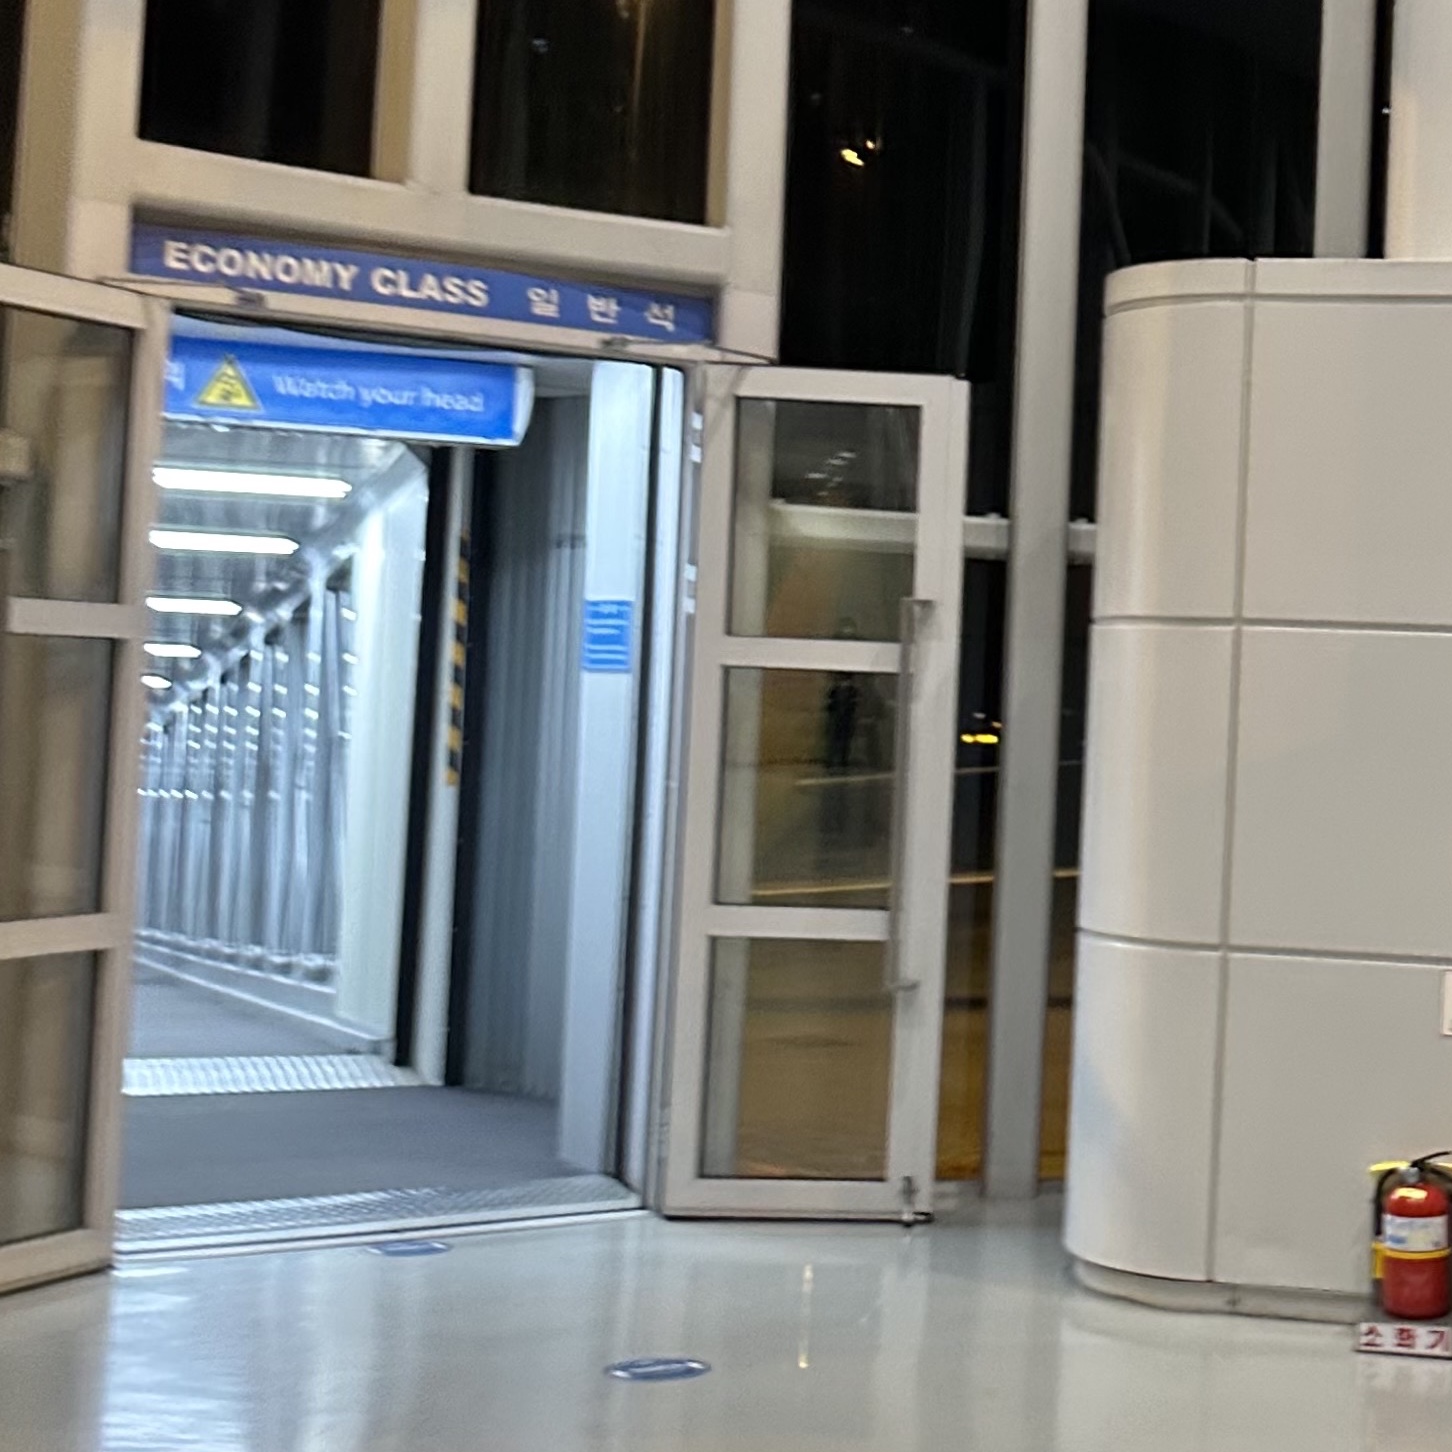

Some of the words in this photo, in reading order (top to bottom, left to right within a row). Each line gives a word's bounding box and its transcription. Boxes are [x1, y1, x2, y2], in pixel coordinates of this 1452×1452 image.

[163, 239, 359, 291] ECONOMY
[370, 266, 489, 307] CLASS
[272, 375, 355, 400] Watch
[357, 386, 418, 408] your
[420, 384, 484, 412] head
